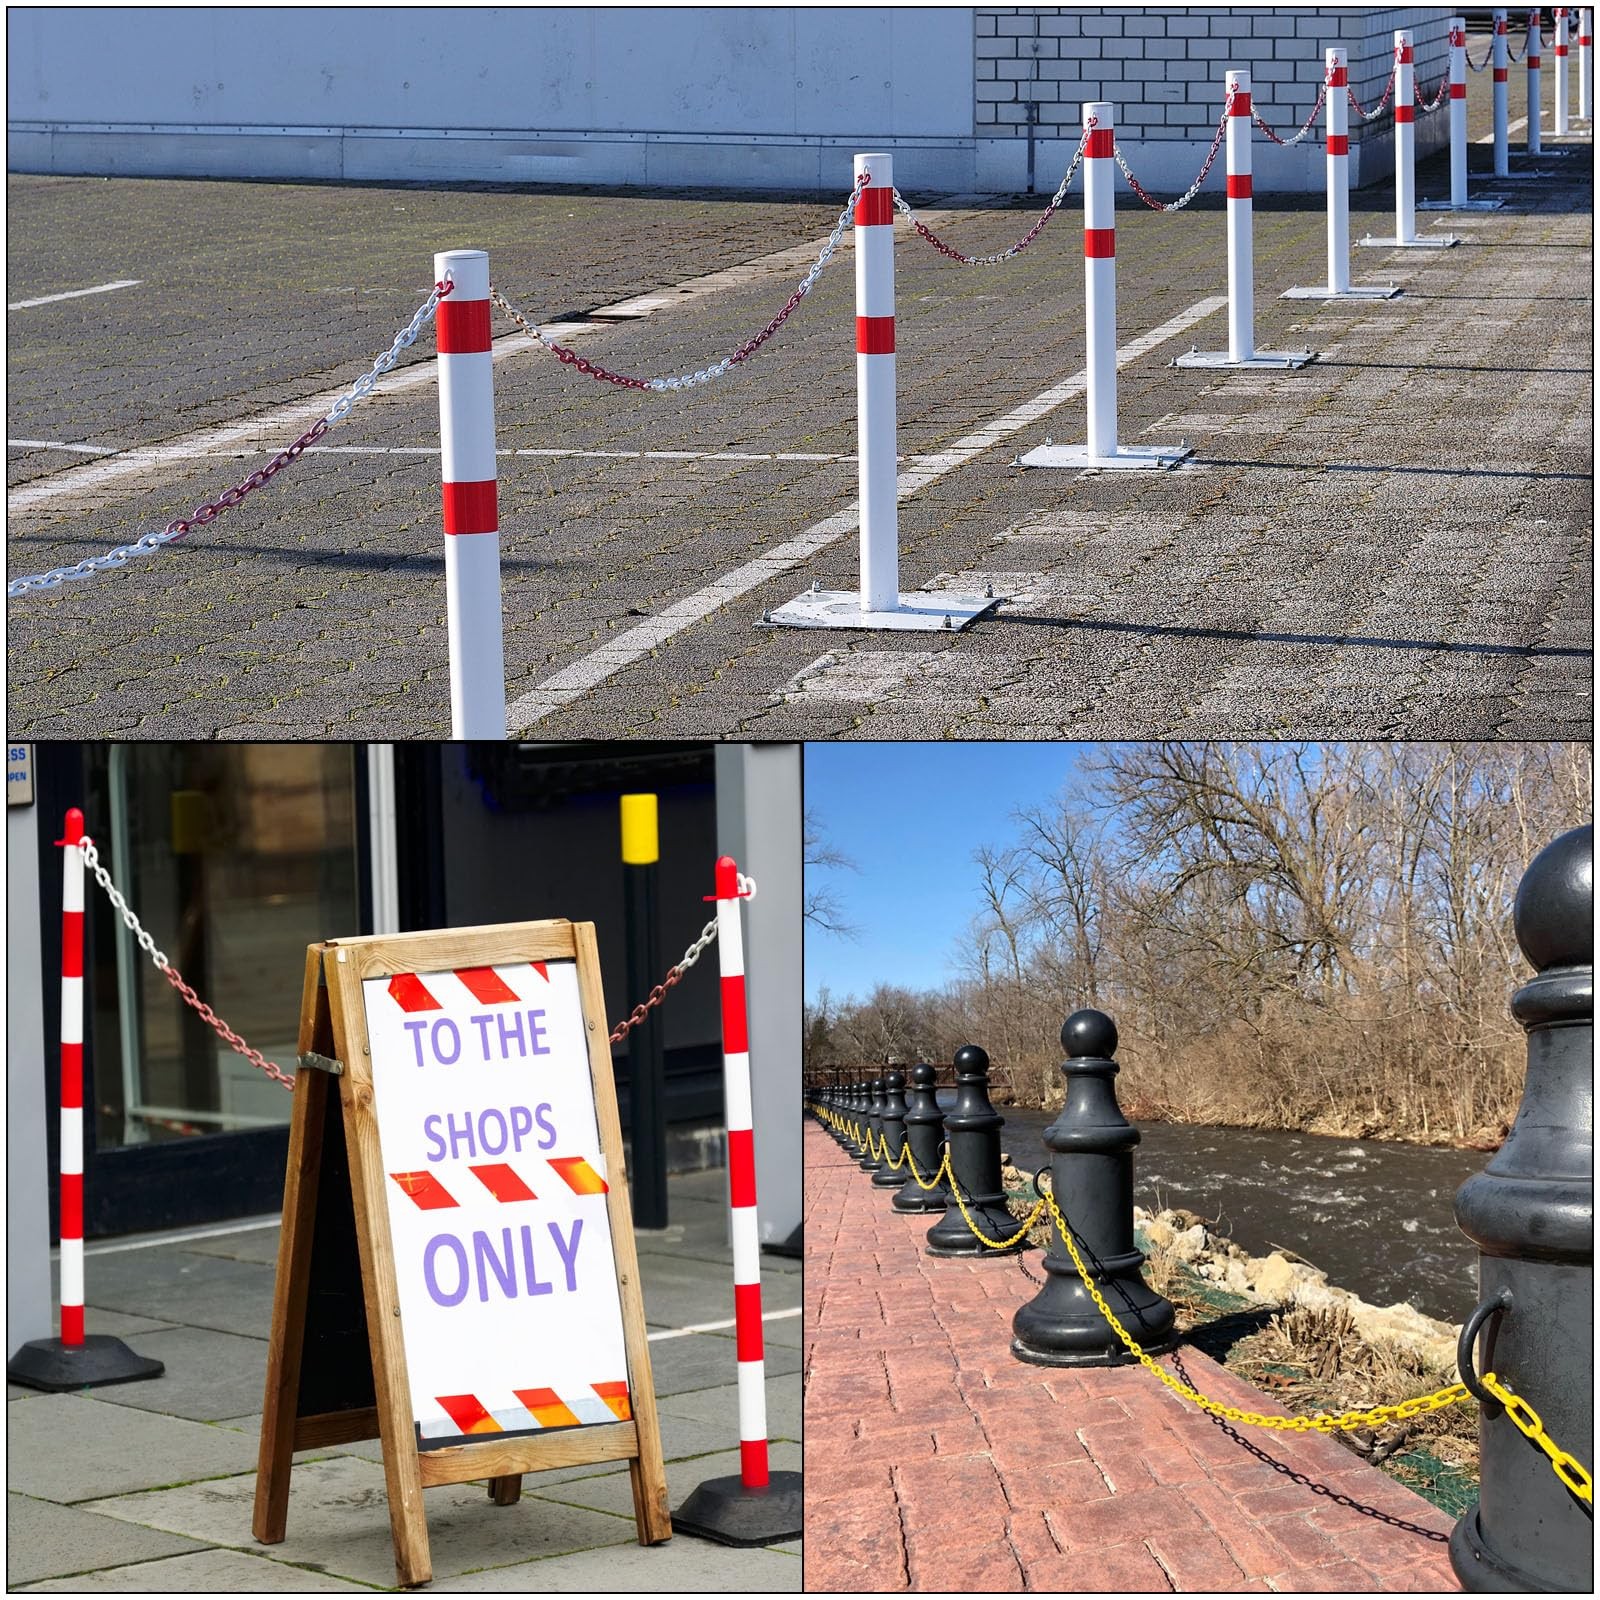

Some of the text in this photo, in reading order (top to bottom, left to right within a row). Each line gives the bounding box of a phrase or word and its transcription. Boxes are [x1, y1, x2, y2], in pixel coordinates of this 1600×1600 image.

[8, 748, 26, 761] SS
[403, 1009, 550, 1067] TO THE
[424, 1103, 557, 1162] SHOPS
[423, 1219, 584, 1307] ONLY
